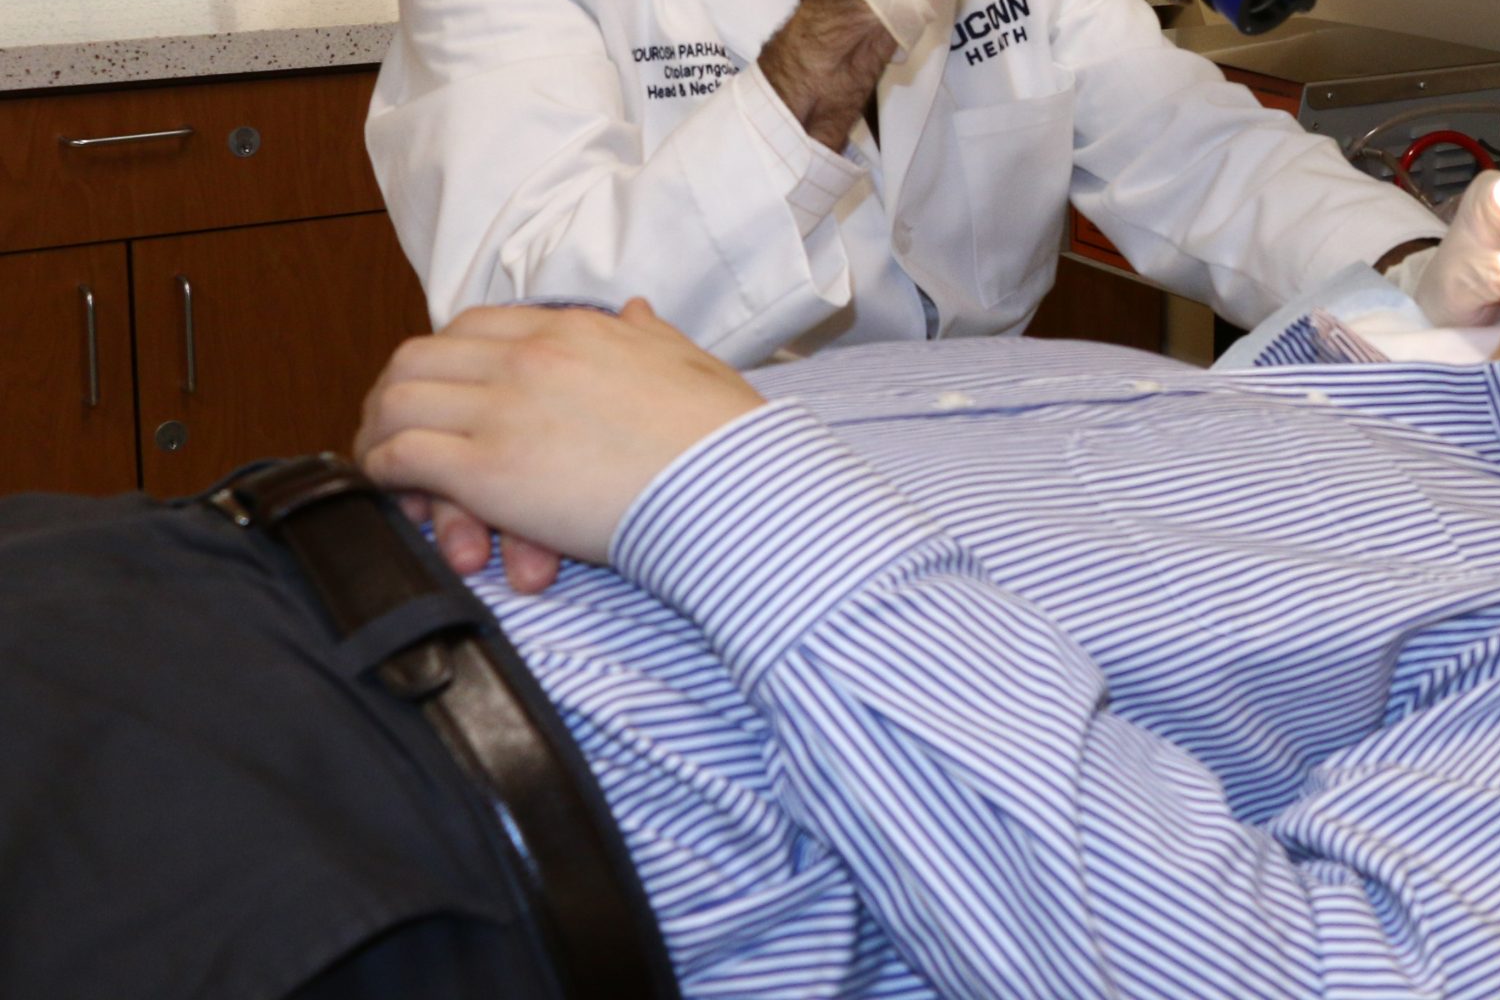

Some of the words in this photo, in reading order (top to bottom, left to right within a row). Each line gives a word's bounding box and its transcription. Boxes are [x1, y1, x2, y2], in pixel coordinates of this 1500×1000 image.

[631, 45, 676, 63] OUROSH
[646, 83, 677, 100] Head
[678, 83, 687, 97] &
